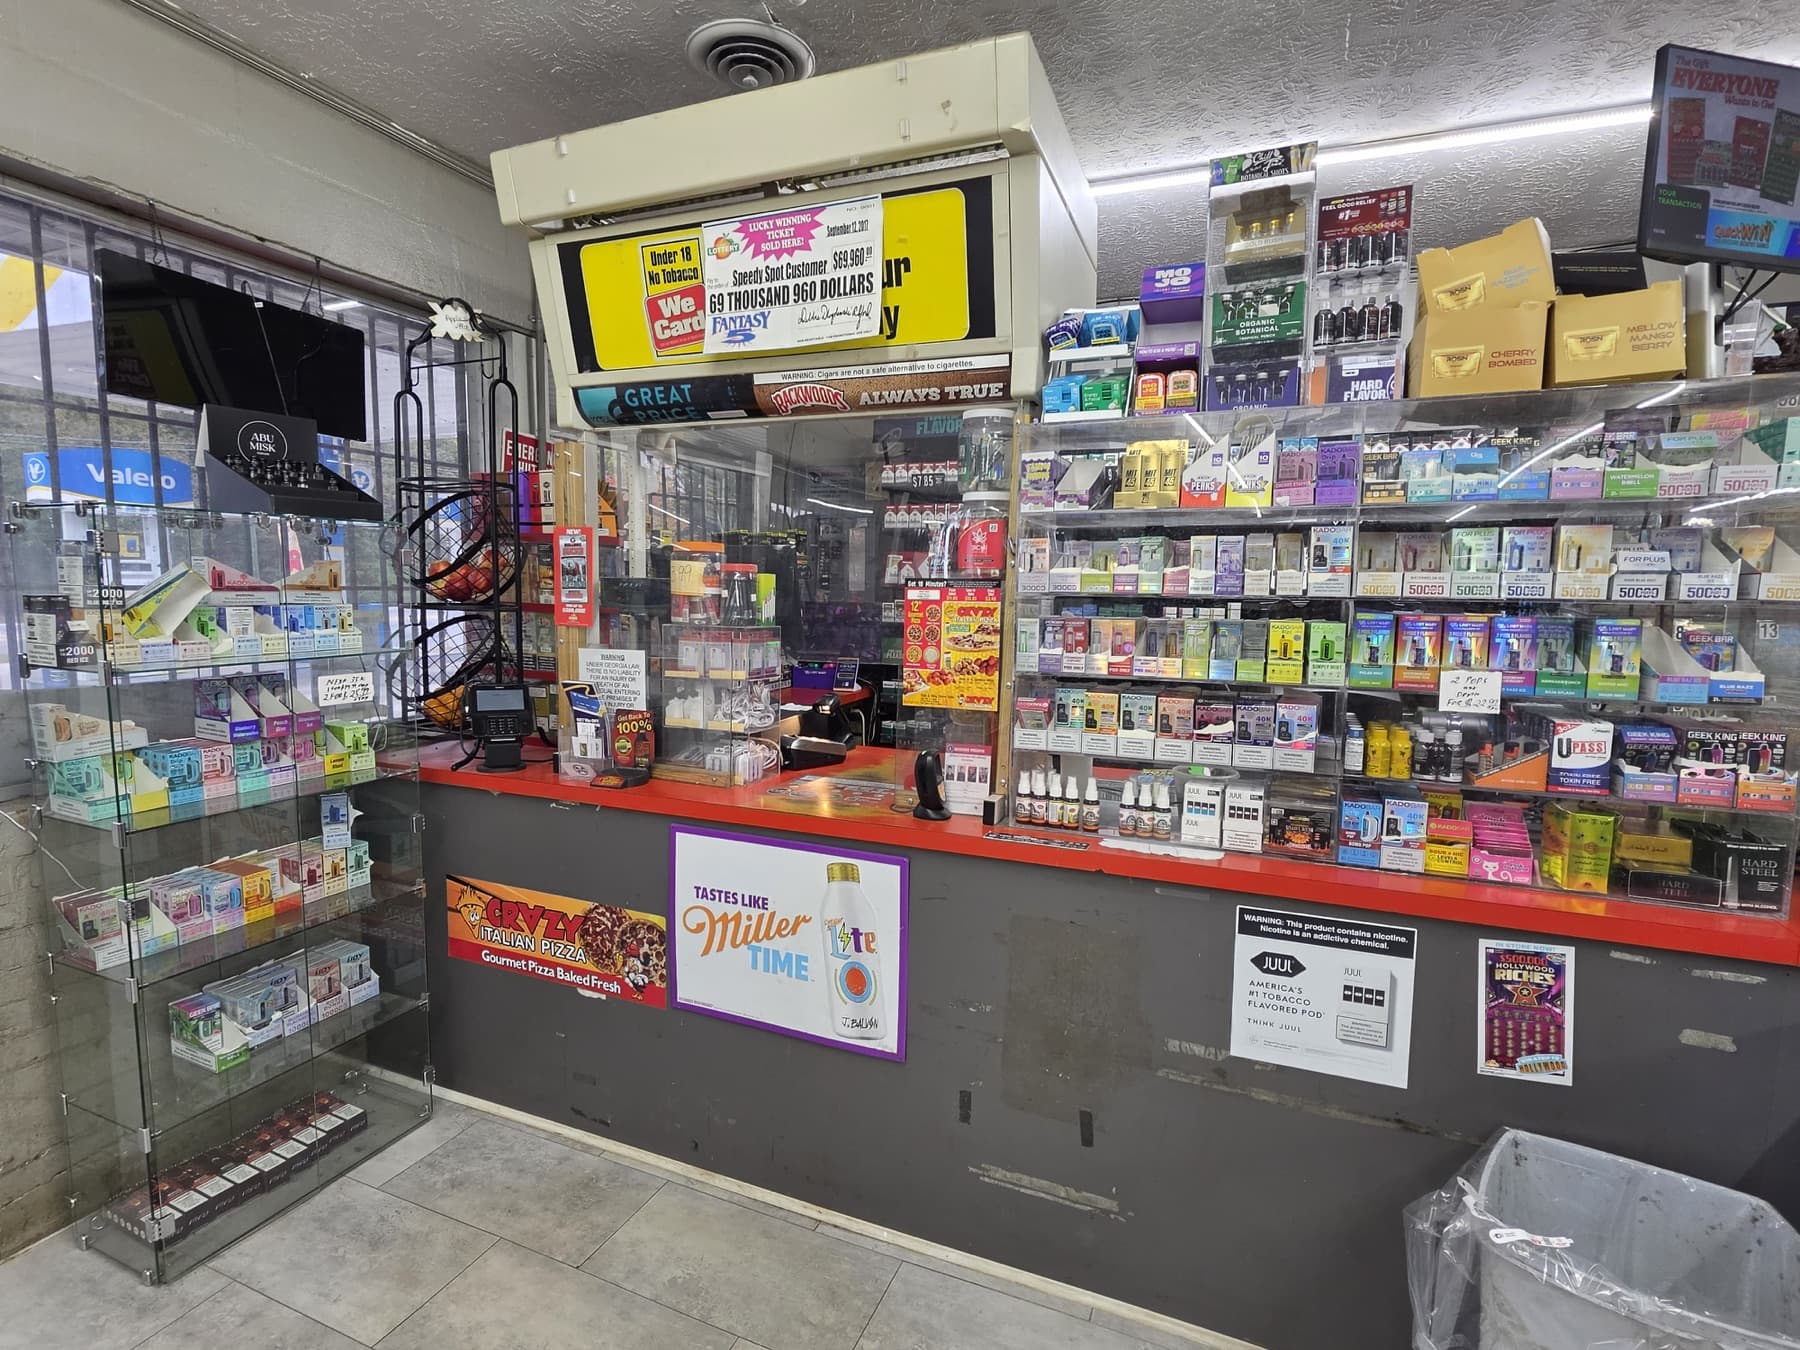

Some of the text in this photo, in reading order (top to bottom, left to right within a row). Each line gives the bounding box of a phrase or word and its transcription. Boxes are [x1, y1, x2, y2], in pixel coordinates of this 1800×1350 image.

[1670, 67, 1780, 99] EVERYONE
[1658, 197, 1702, 209] TRANSACTION
[749, 213, 812, 232] LUCKY WINNING
[766, 228, 795, 239] TICKET
[826, 223, 852, 237] September
[708, 243, 739, 256] LOTTERY
[761, 237, 805, 251] SOLD HERE!
[650, 246, 692, 266] Under 18
[833, 250, 865, 272] $69,960
[648, 267, 698, 285] No Tobacco
[732, 259, 828, 287] Speedy Spot Customer
[709, 271, 874, 314] 69 THOUSAND 960 DOLLARS
[657, 295, 696, 319] We
[654, 309, 705, 340] Card
[712, 310, 772, 336] FANTASY
[1239, 319, 1276, 328] ORGANIC
[1626, 321, 1678, 334] MELLOW
[726, 328, 757, 345] 5
[1235, 325, 1279, 336] BOTANICAL
[1630, 332, 1675, 343] MANGO
[1631, 341, 1673, 352] BERRY
[1490, 349, 1537, 359] CHERRY
[781, 372, 816, 381] WARNING:
[818, 369, 839, 379] Cigars
[841, 369, 852, 377] are
[853, 367, 865, 376] not
[872, 366, 887, 375] safe
[888, 363, 926, 374] alternative
[927, 362, 935, 370] to
[936, 359, 975, 371] cigarettes.
[1488, 358, 1537, 369] BOMBED
[1350, 379, 1384, 392] HARD
[624, 383, 692, 407] GREAT
[771, 382, 1004, 416] BACKWOODS ALWAYS TRUE
[251, 432, 275, 443] ABU
[1491, 437, 1533, 446] GEEK KING
[249, 441, 276, 453] MISK
[1125, 469, 1138, 478] MIT
[1144, 469, 1157, 478] MIT
[1164, 468, 1177, 477] MIT
[1609, 473, 1655, 481] WATERMELON
[1124, 477, 1137, 488] 45
[1143, 476, 1156, 488] 45
[1163, 476, 1175, 487] 45
[1191, 480, 1215, 491] PERKS
[1675, 626, 1684, 639] 8
[1760, 623, 1778, 639] 13
[1689, 634, 1734, 643] GEEK BAR
[66, 645, 95, 656] 2000
[601, 654, 625, 662] WARNING
[617, 719, 652, 734] 100%
[1687, 731, 1738, 741] GEEK KING
[1762, 732, 1787, 742] KING
[1559, 777, 1601, 786] TOXIN FREE
[1229, 792, 1242, 800] JUUL
[1345, 802, 1381, 810] KADOBAR
[1386, 800, 1428, 809] KADOBAR
[1407, 812, 1425, 820] 40K
[1742, 858, 1778, 869] HARD
[1741, 867, 1779, 878] STEEL
[694, 885, 769, 911] TASTES LIKE
[682, 905, 812, 958] Miller
[1243, 913, 1409, 944] WARNING: This product contains nicotine.
[1260, 924, 1292, 936] Nicotine
[1292, 927, 1301, 936] is
[1312, 931, 1349, 944] addictive
[1350, 936, 1390, 950] chemical.
[480, 926, 587, 964] ITALIAN PIZZA
[747, 944, 809, 982] TIME
[1263, 956, 1293, 974] JUUL
[1495, 963, 1556, 974] HOLLYWOOD
[481, 949, 621, 995] Gourmet Pizza Baked Fresh
[1344, 967, 1362, 977] JUUL
[1494, 968, 1557, 986] RICHES
[1248, 979, 1303, 995] AMERICA'S
[1248, 990, 1312, 1006] #1 TOBACCO
[1247, 1000, 1298, 1015] FLAVORED
[1247, 1017, 1302, 1033] THINK JUUL
